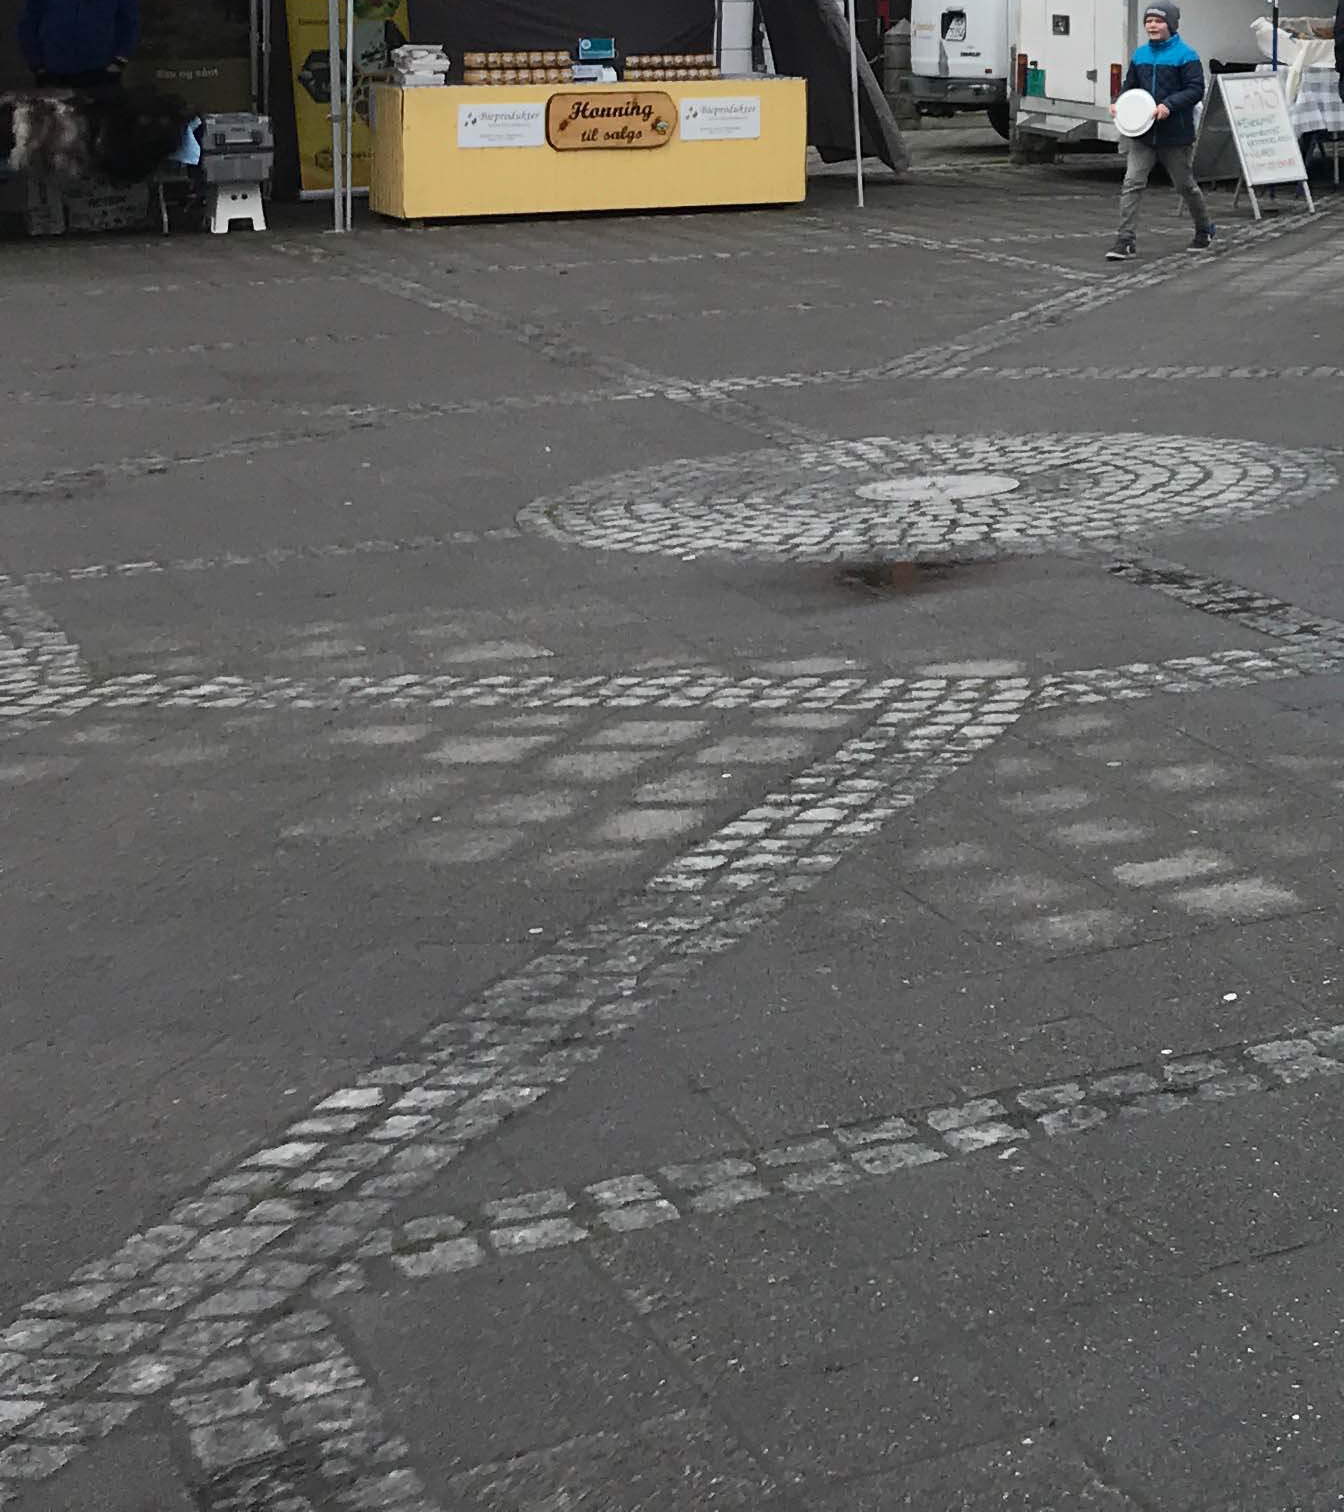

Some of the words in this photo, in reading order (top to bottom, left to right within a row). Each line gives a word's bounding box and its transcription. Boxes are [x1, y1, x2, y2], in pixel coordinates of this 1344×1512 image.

[568, 100, 654, 123] Honning
[581, 129, 597, 143] til
[601, 128, 643, 145] salgs
